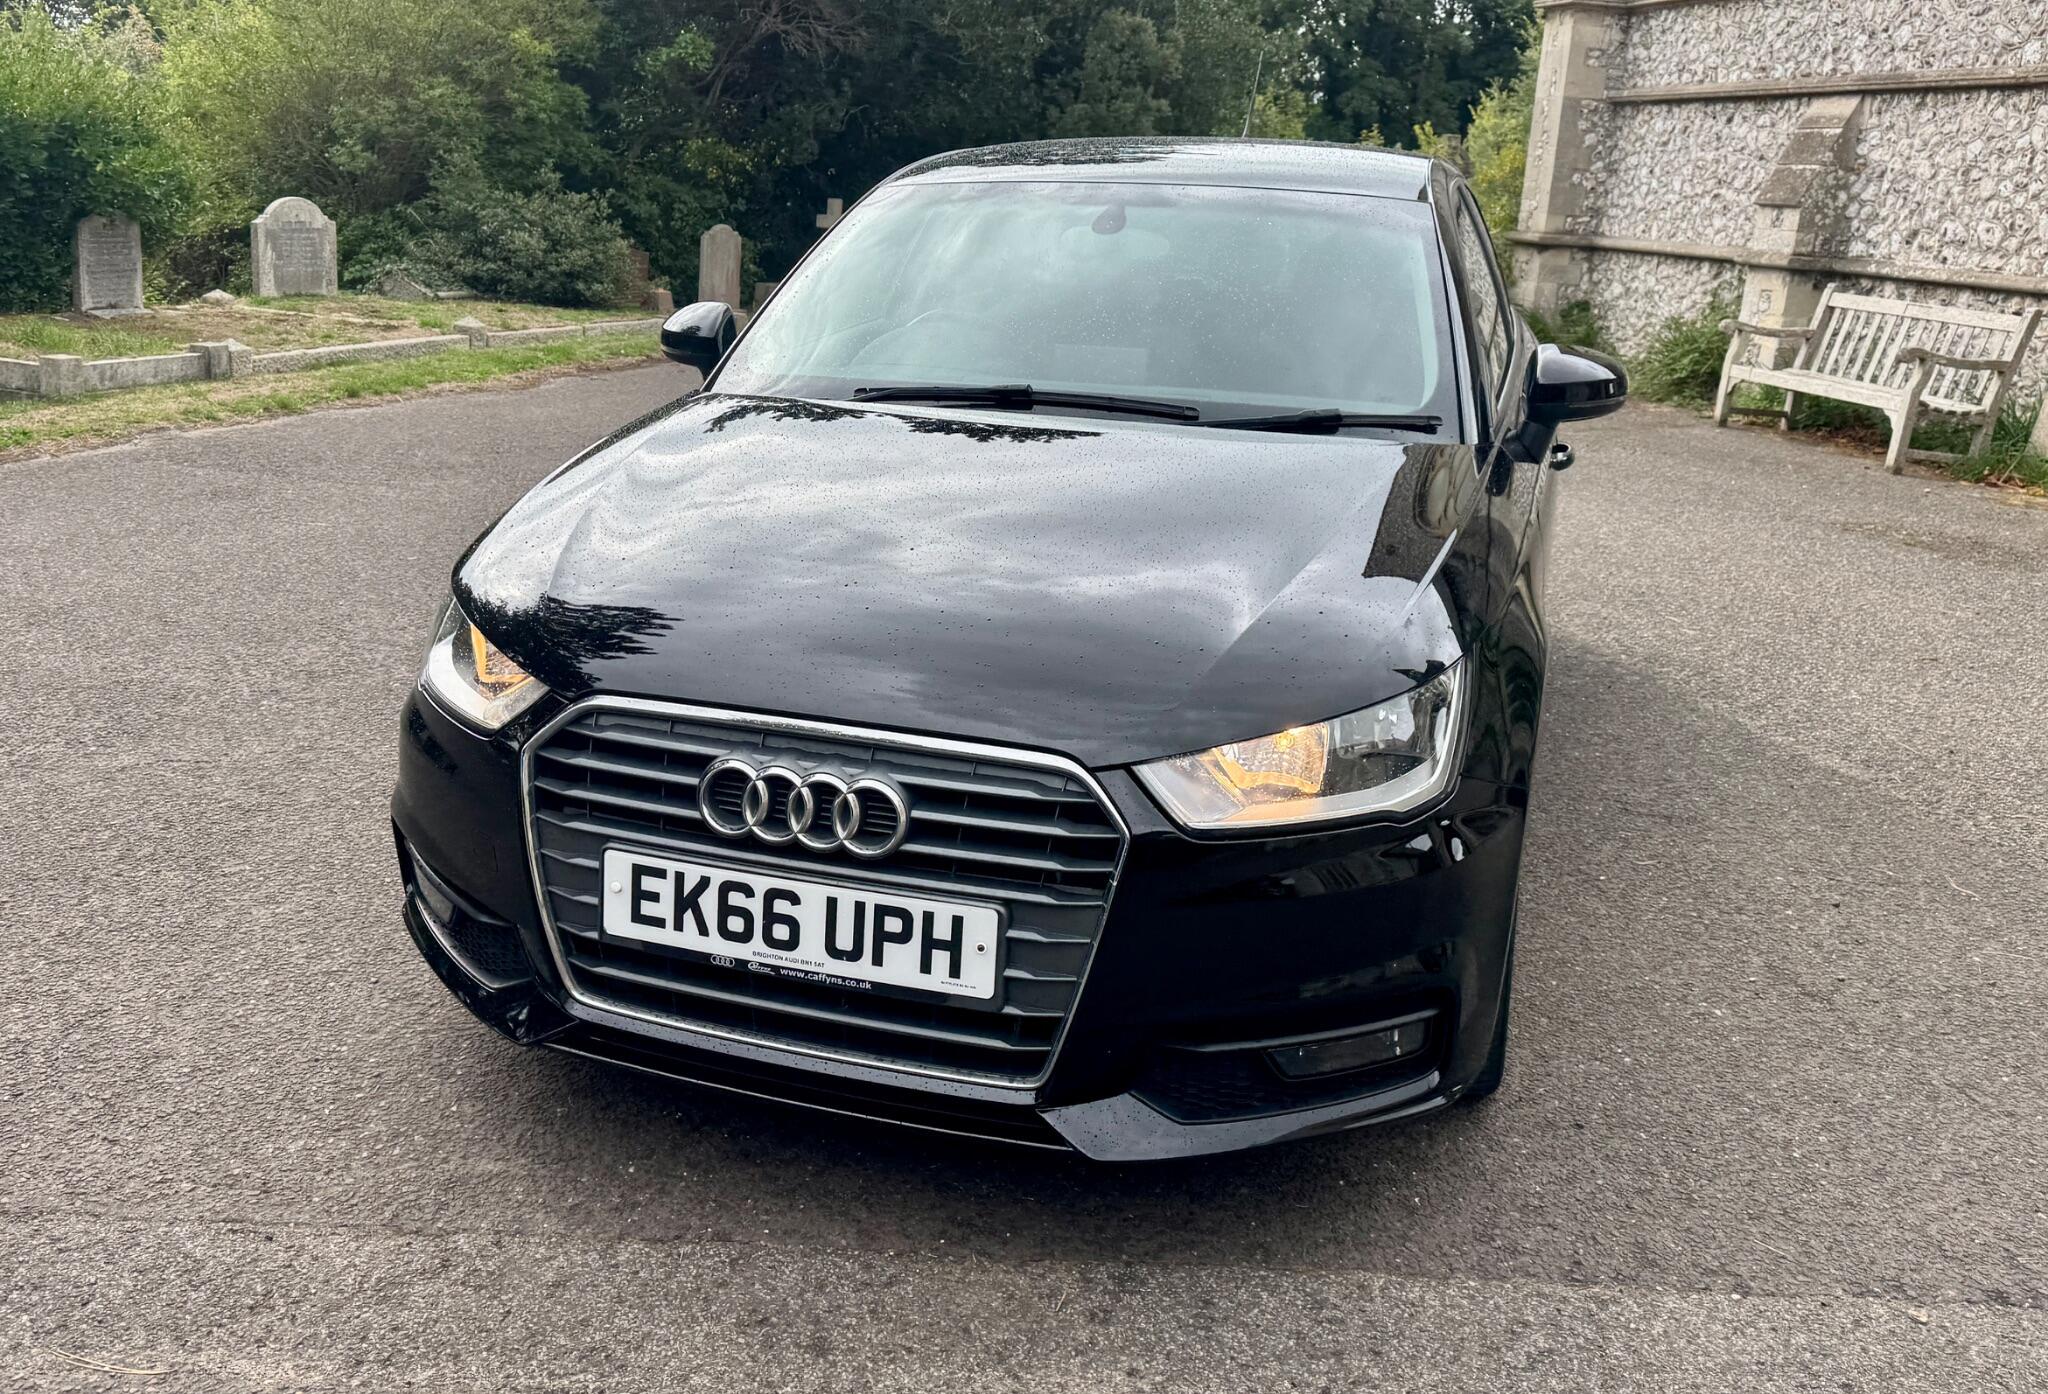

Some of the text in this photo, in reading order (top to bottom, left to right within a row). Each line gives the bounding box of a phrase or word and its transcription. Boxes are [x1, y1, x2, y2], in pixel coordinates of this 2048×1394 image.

[630, 862, 965, 980] EK66 UPH
[752, 951, 784, 961] BRIGHTON
[784, 956, 800, 965] AUDI
[780, 968, 872, 990] www.caffyns.co.uk
